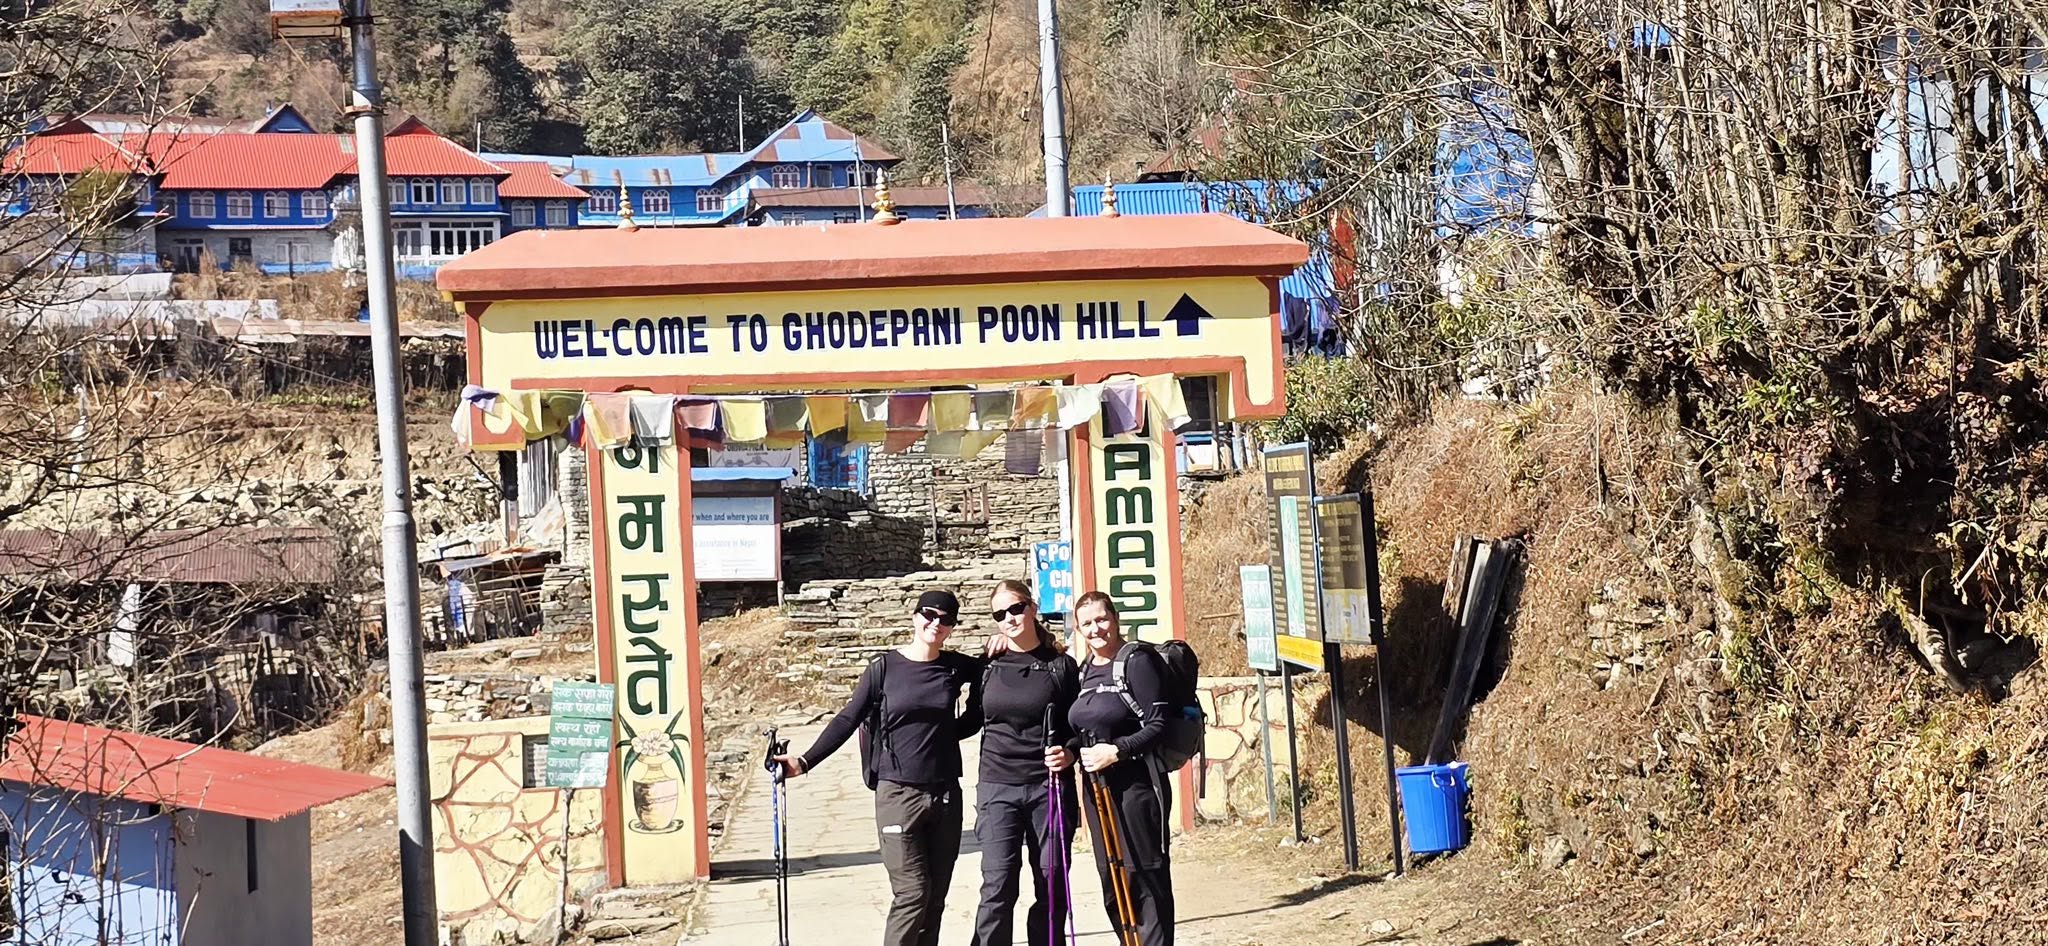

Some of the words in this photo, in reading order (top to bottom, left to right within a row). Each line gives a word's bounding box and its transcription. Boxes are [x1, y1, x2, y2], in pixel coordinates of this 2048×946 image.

[726, 313, 768, 352] TO
[781, 307, 962, 352] GHODEPANI
[977, 303, 1061, 343] POON
[1076, 300, 1160, 340] HILL
[695, 512, 712, 521] when
[713, 512, 725, 521] and
[726, 512, 745, 521] where
[746, 514, 758, 523] you
